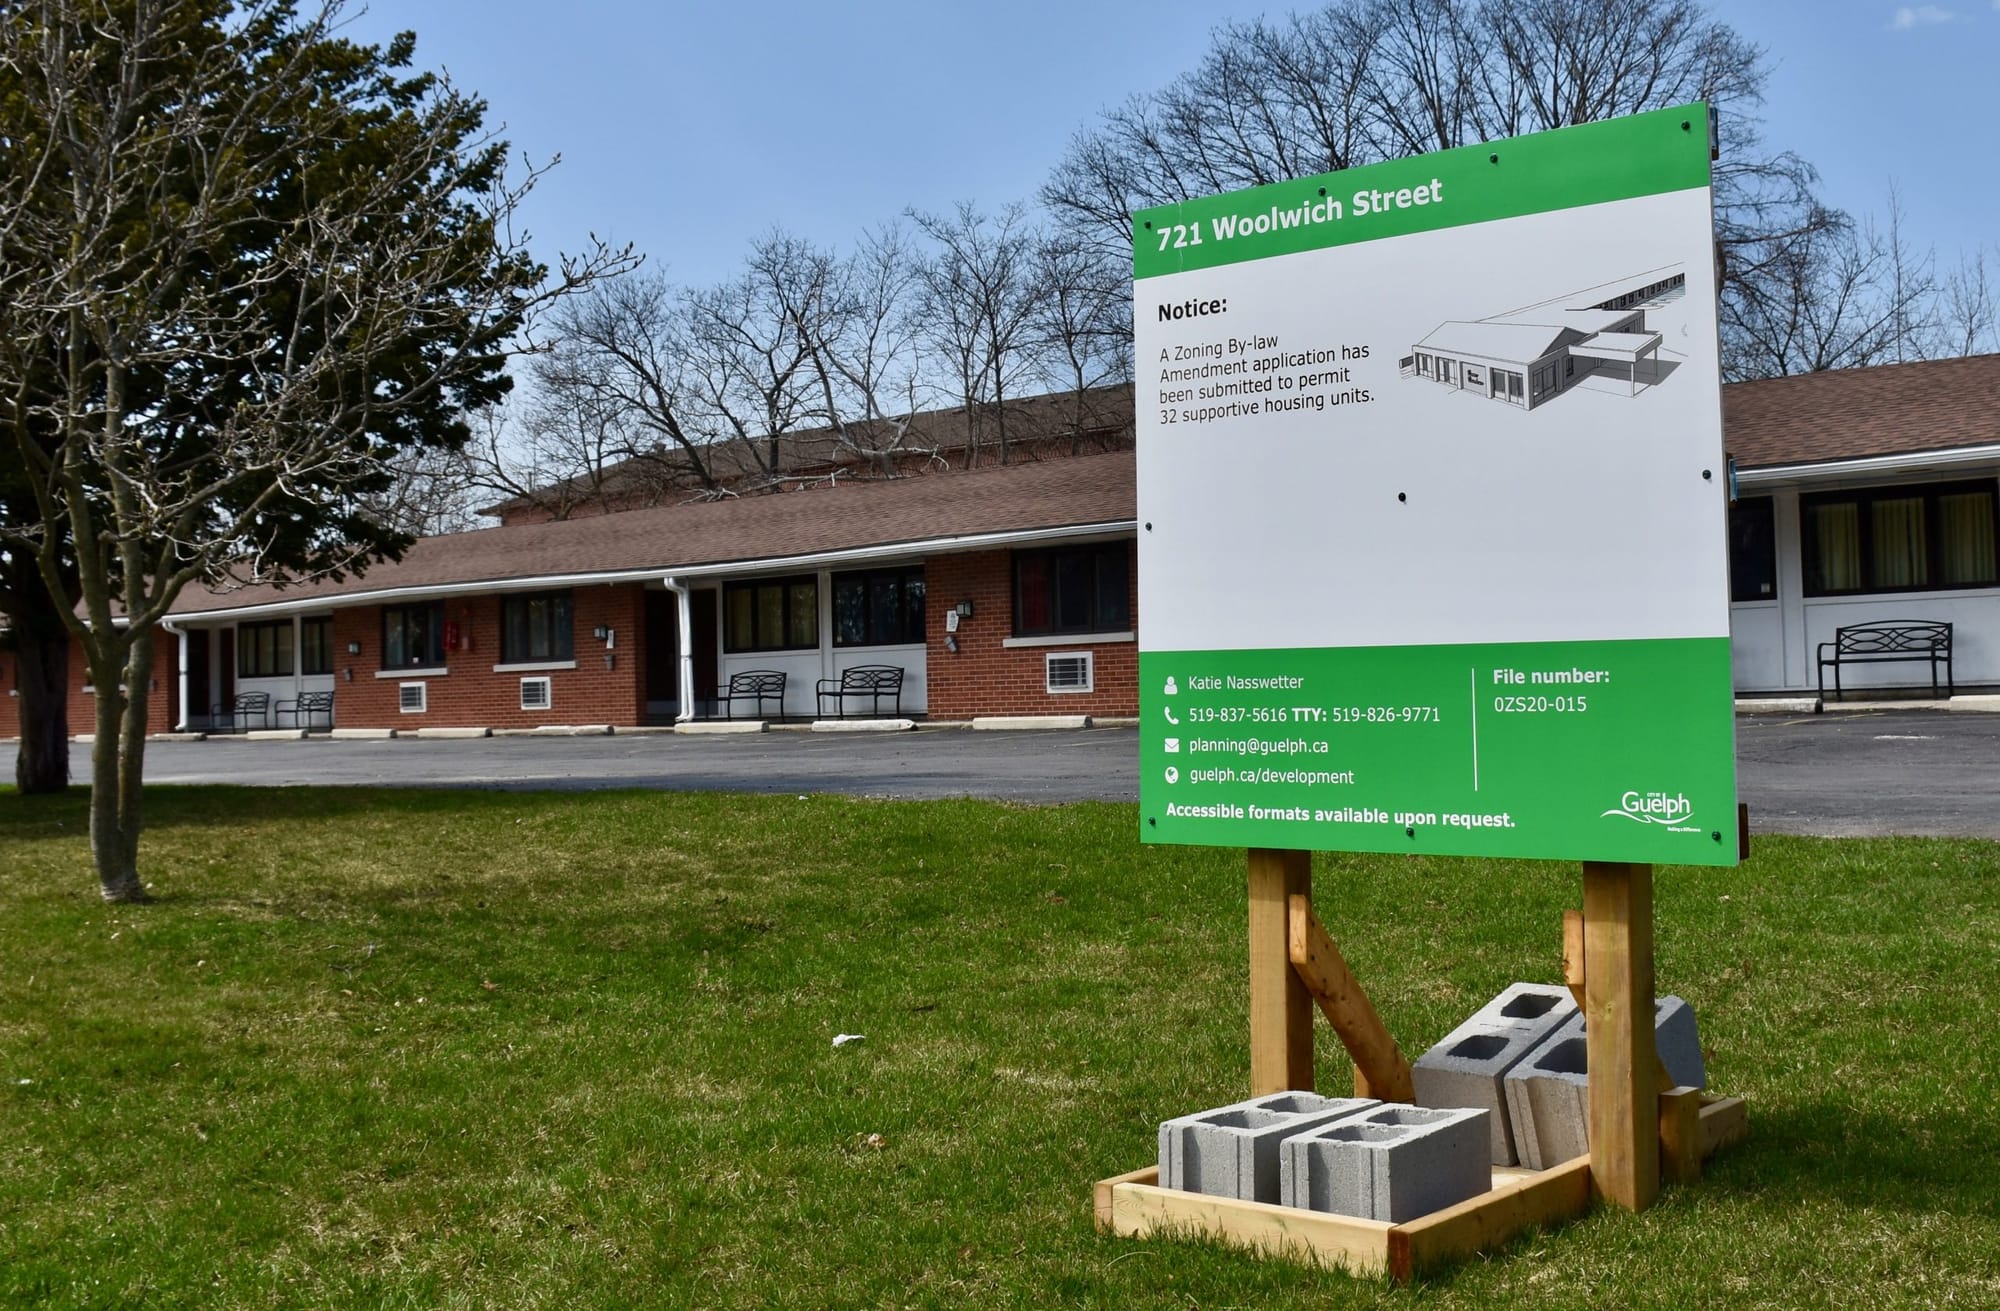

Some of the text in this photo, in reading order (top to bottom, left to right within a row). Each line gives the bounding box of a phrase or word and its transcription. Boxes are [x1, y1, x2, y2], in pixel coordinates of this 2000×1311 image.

[1157, 178, 1443, 251] 721 Woolwich Street
[1158, 298, 1227, 323] Notice:
[1160, 334, 1279, 362] A Zoning By-law
[1160, 344, 1370, 384] Amendment application has
[1160, 367, 1351, 404] been submitted to permit
[1160, 387, 1376, 425] 32 supportive housing units.
[1188, 674, 1304, 691] Katie Nasswetter
[1493, 667, 1611, 685] File number:
[1188, 706, 1441, 723] 519-837-5616 TTY: 519-826-9771
[1189, 737, 1329, 756] planning@guelph.ca
[1190, 766, 1354, 787] guelph.ca/development
[1165, 802, 1516, 830] Accessible formats available upon request.
[1621, 790, 1690, 818] Guelph
